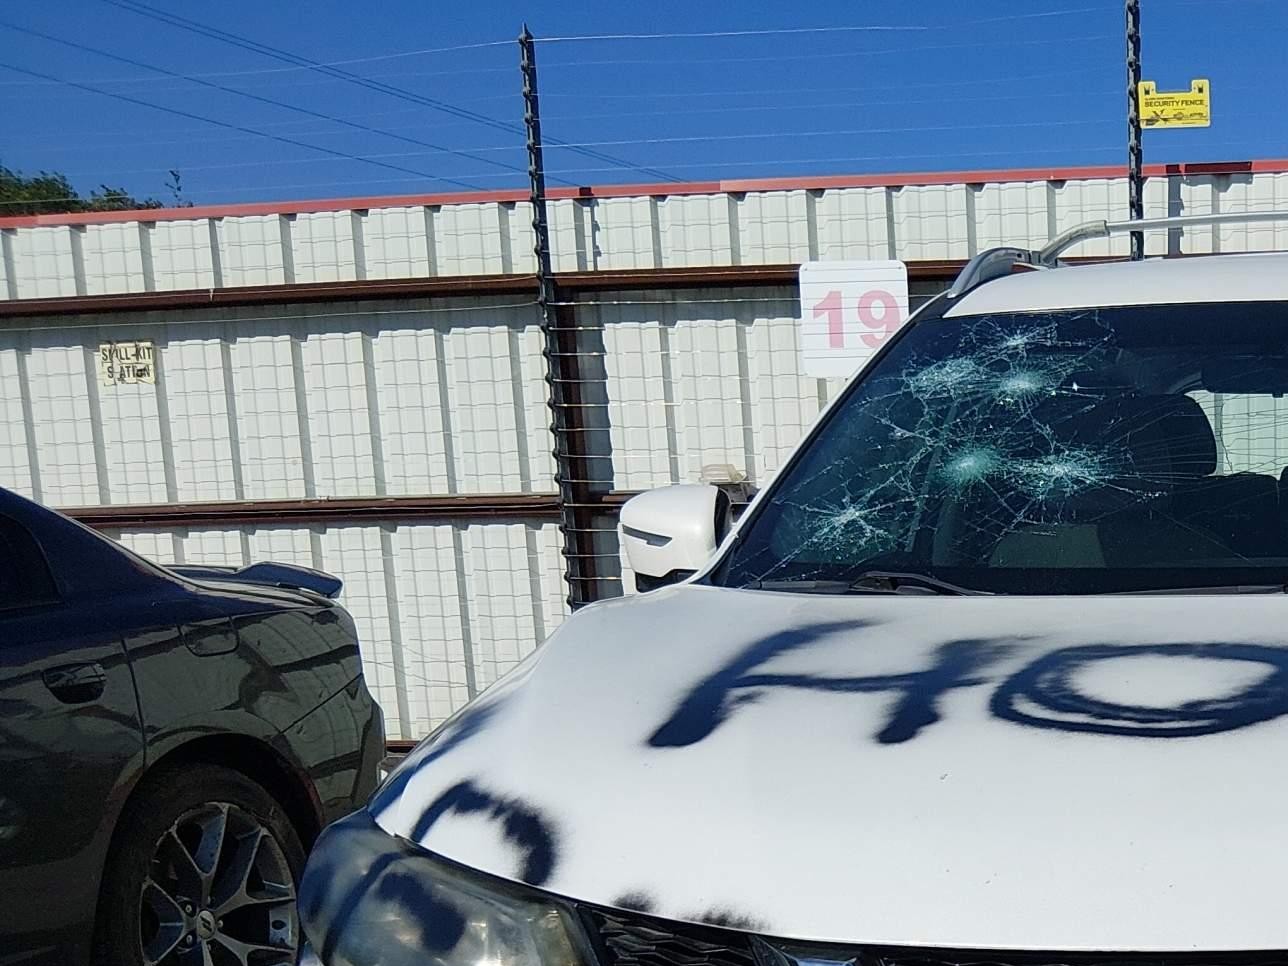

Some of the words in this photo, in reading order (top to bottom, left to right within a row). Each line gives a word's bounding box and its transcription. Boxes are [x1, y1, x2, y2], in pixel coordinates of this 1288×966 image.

[1144, 100, 1180, 108] SECURITY
[813, 290, 901, 349] 19
[107, 365, 151, 379] SATION
